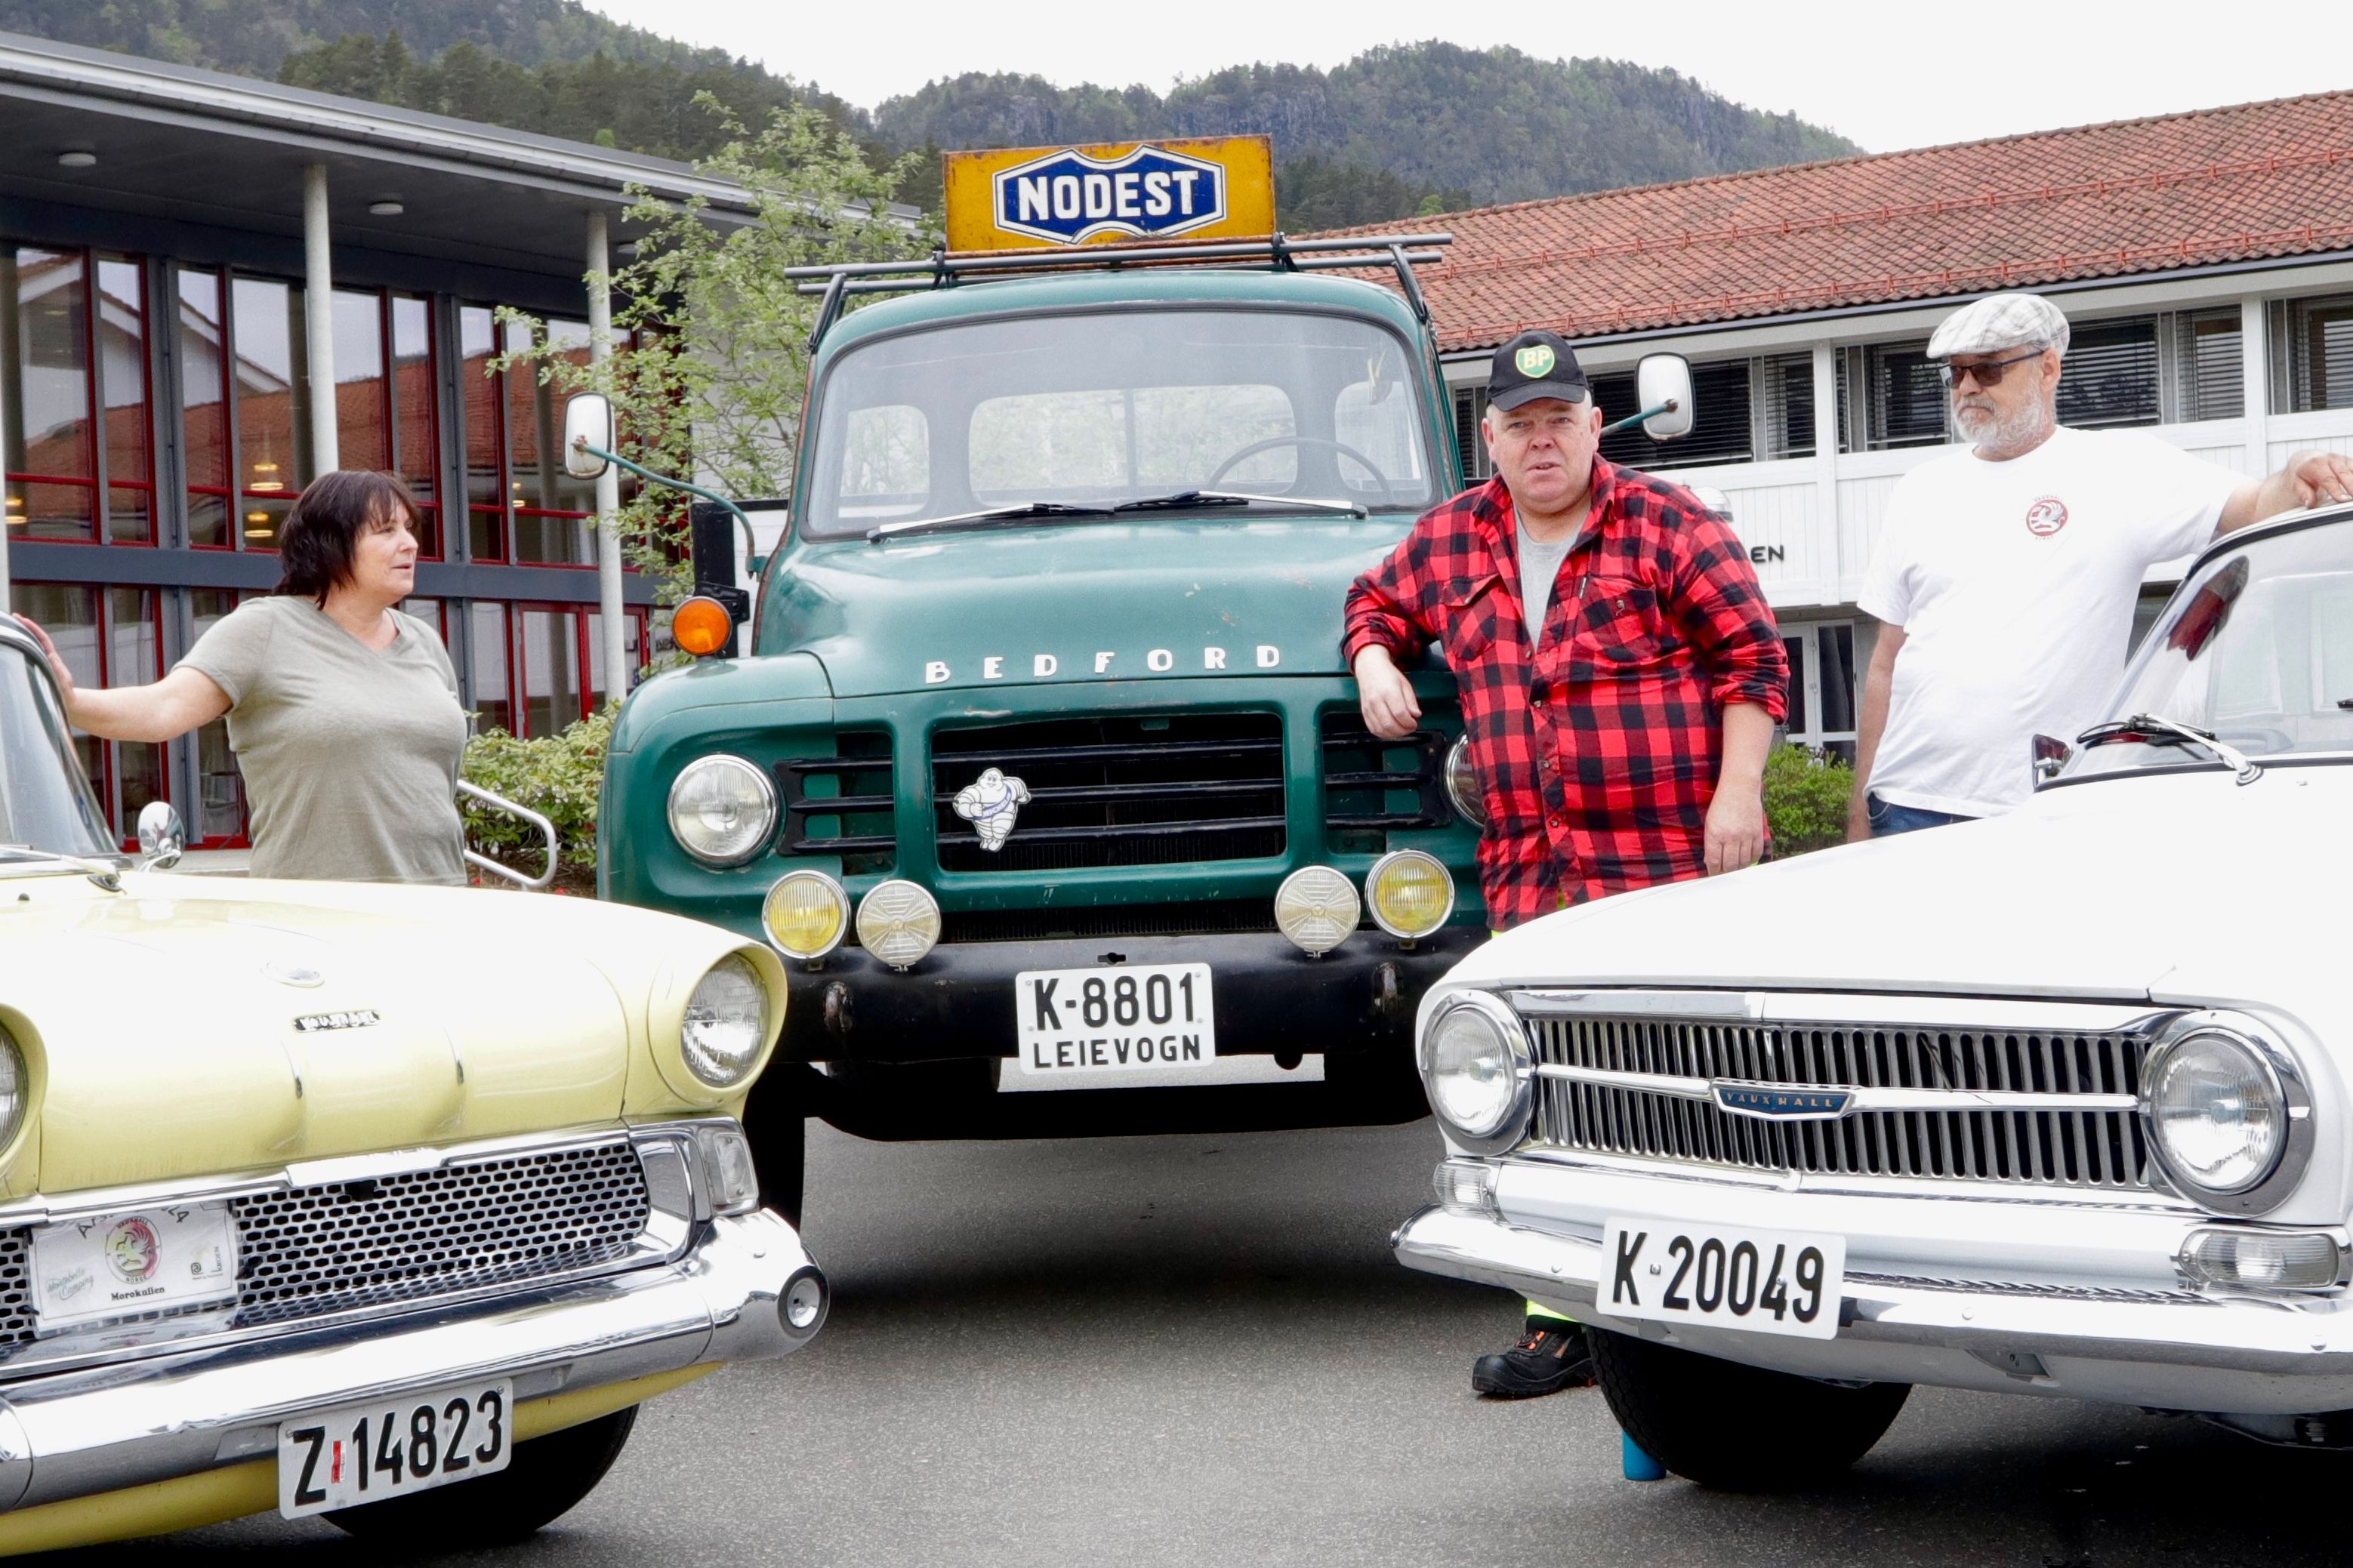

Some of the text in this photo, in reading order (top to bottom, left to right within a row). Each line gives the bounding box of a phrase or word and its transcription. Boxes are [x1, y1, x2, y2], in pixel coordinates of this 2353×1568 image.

[1017, 170, 1199, 221] NODEST
[1523, 350, 1550, 368] BP
[925, 645, 1280, 684] BEDFORD
[1034, 972, 1195, 1030] K-8801
[1033, 1034, 1201, 1069] LEIEVOGN
[1726, 1092, 1833, 1108] VAUXHALL
